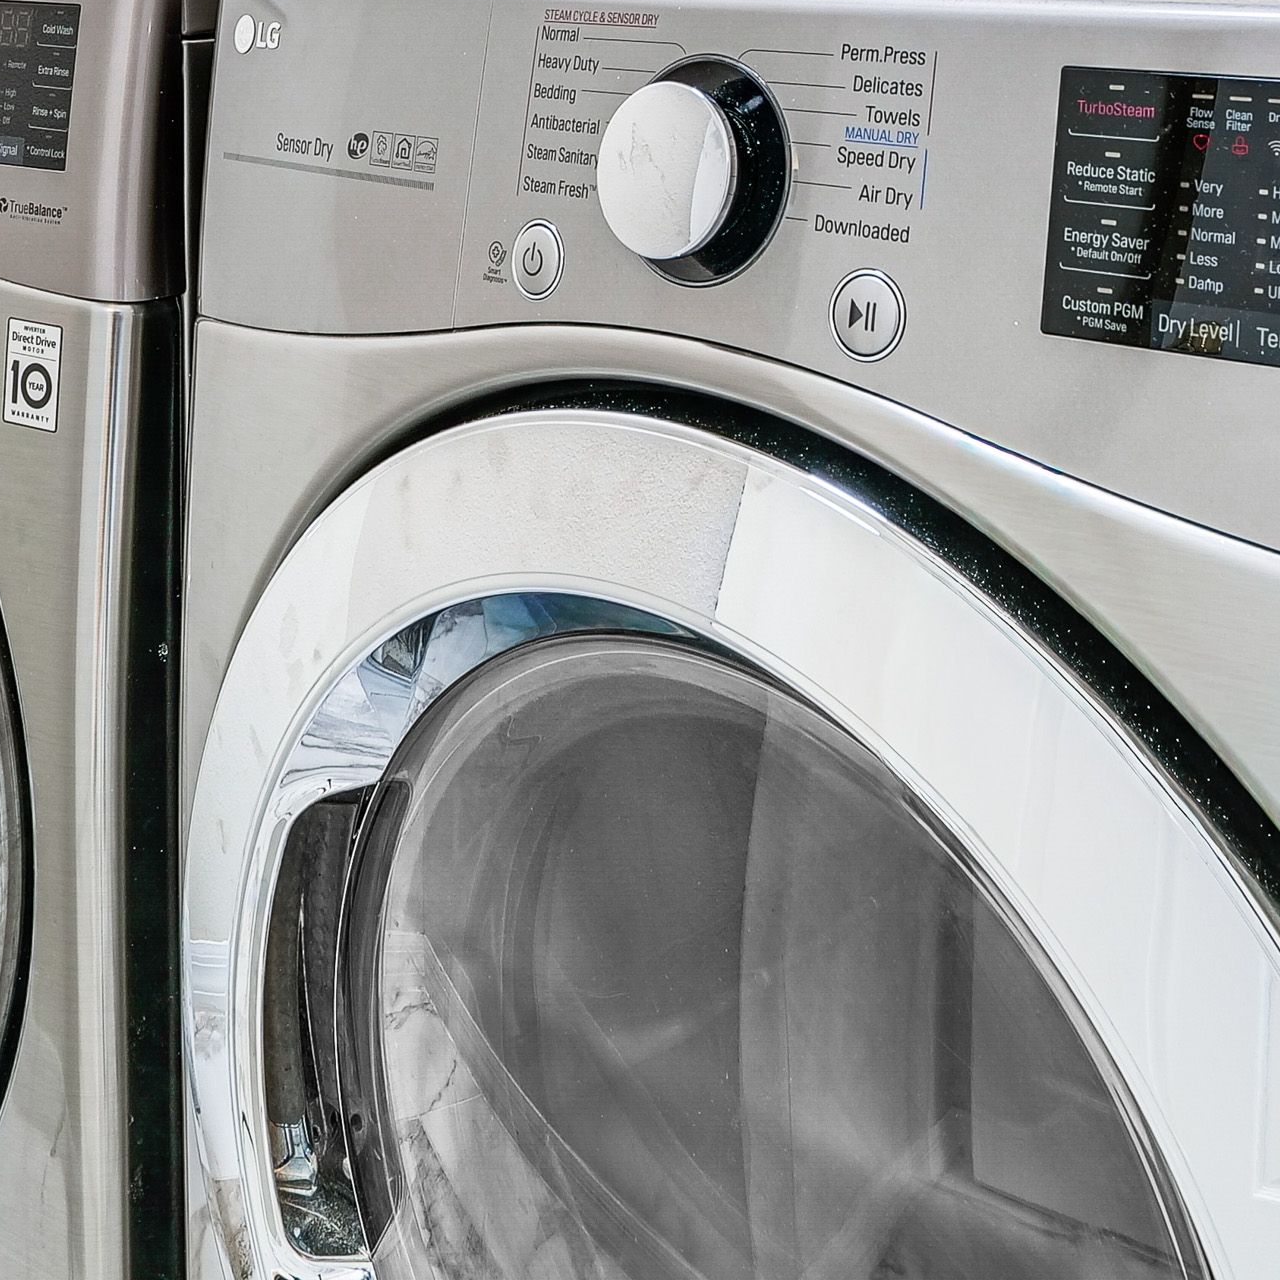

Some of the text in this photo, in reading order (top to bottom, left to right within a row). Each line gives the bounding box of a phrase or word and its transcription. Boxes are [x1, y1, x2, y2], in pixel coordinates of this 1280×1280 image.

[544, 9, 659, 26] STEAM CYCLE & SENSOR DRY
[42, 24, 73, 35] Cold Wash
[255, 21, 281, 49] LG
[541, 25, 580, 42] Normal
[841, 43, 926, 66] Perm.Press
[38, 65, 69, 77] Extra Rinse
[537, 53, 600, 75] Heavy Duty
[5, 89, 16, 98] High
[533, 83, 576, 104] Bedding
[853, 75, 923, 97] Delicates
[32, 106, 67, 120] Rinse Spin
[865, 105, 921, 127] Towels
[1077, 100, 1155, 118] TurboSteam
[1190, 107, 1213, 118] Flow
[1225, 109, 1253, 121] Clean
[530, 113, 600, 135] Antibacterial
[1186, 118, 1216, 130] Sense
[1225, 120, 1252, 132] Filter
[845, 126, 919, 145] MANUAL DRY
[29, 146, 65, 159] Control Lock
[276, 132, 334, 162] Sensor Dry
[526, 143, 557, 162] Steam
[837, 146, 916, 174] Speed Dry
[1067, 161, 1156, 183] Reduce Static
[523, 176, 556, 195] Steam
[1084, 181, 1143, 196] Remote Start
[1194, 179, 1223, 196] Very
[858, 184, 913, 210] Air Dry
[1192, 204, 1224, 218] More
[814, 214, 910, 243] Downloaded
[1190, 227, 1236, 245] Normal
[1064, 227, 1150, 251] Energy Saver
[1076, 247, 1142, 265] Default On/Off
[1189, 251, 1218, 267] Less
[1188, 275, 1224, 294] Damp
[1062, 295, 1144, 320] Custom PGM
[23, 325, 46, 334] INVERTER
[1082, 316, 1127, 333] PGM Save
[1158, 313, 1233, 342] Dry Level
[12, 331, 56, 349] Direct Drive
[22, 345, 44, 355] MOTOR
[11, 359, 52, 409] 10
[28, 381, 45, 392] YEAR
[11, 409, 49, 423] WARRANTY
